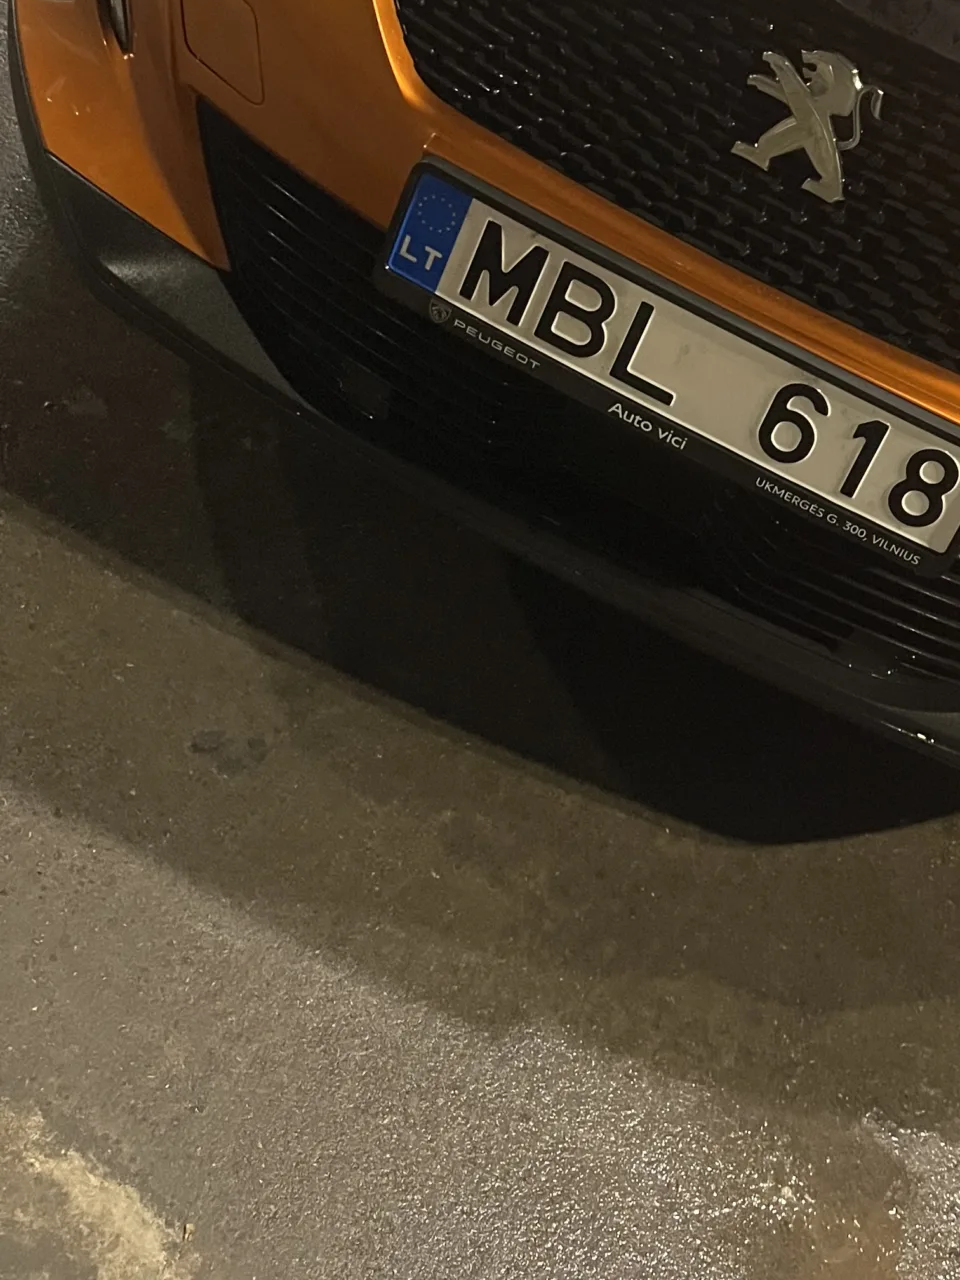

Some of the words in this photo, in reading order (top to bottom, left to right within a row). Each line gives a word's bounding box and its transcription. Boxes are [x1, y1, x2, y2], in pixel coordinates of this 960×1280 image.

[399, 234, 443, 271] LT
[453, 319, 541, 369] PEUGEOT
[458, 219, 676, 406] MBL
[758, 383, 960, 527] 618
[608, 402, 652, 432] Auto
[658, 426, 688, 450] vici
[827, 513, 840, 527] G.
[842, 520, 868, 542] 300,
[872, 534, 921, 565] VILNIUS
